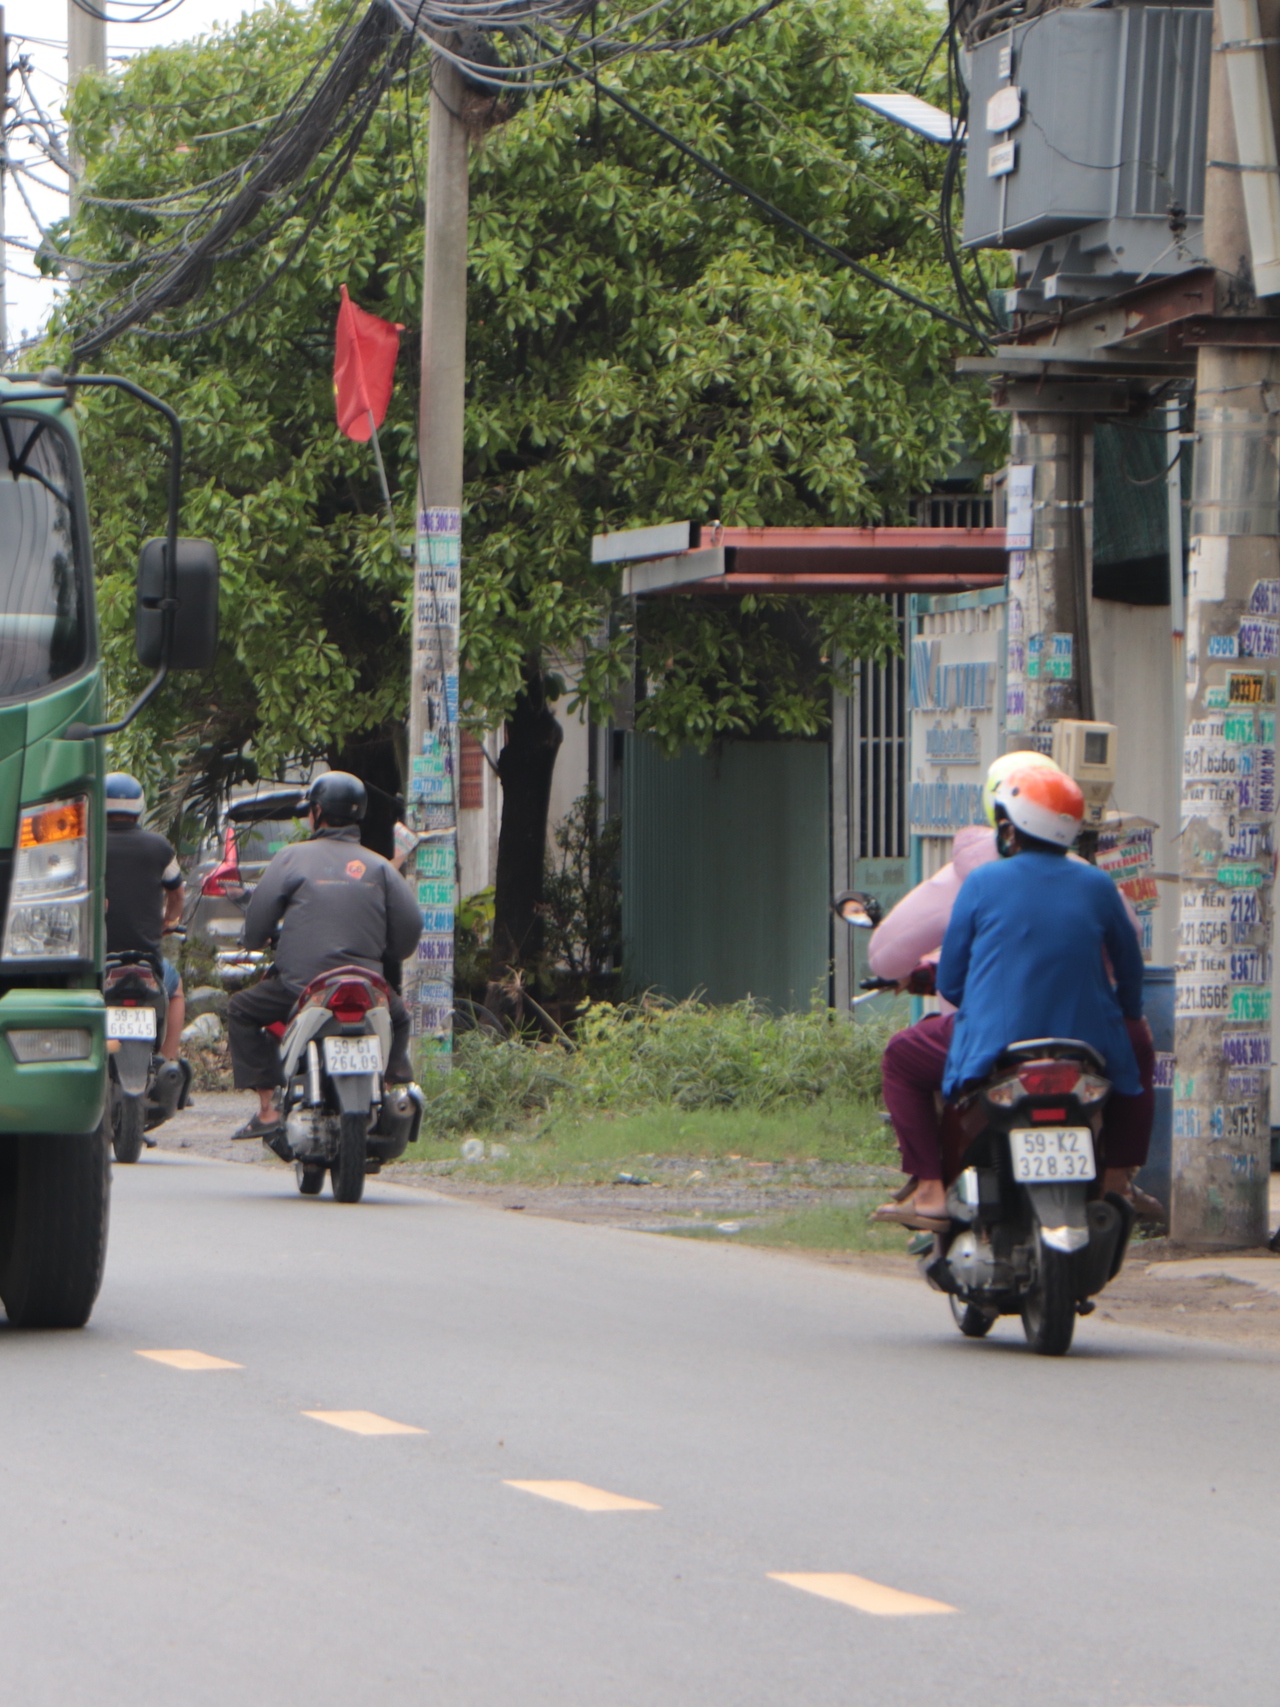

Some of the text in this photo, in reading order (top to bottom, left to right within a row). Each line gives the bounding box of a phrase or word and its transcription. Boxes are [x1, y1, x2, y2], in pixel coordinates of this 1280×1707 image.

[114, 1009, 146, 1023] 59-X1
[110, 1022, 153, 1036] 665.45
[333, 1039, 371, 1055] 59-G1
[330, 1054, 379, 1071] 264.09
[1023, 1131, 1080, 1154] 59-K2
[1019, 1154, 1089, 1177] 328.32
